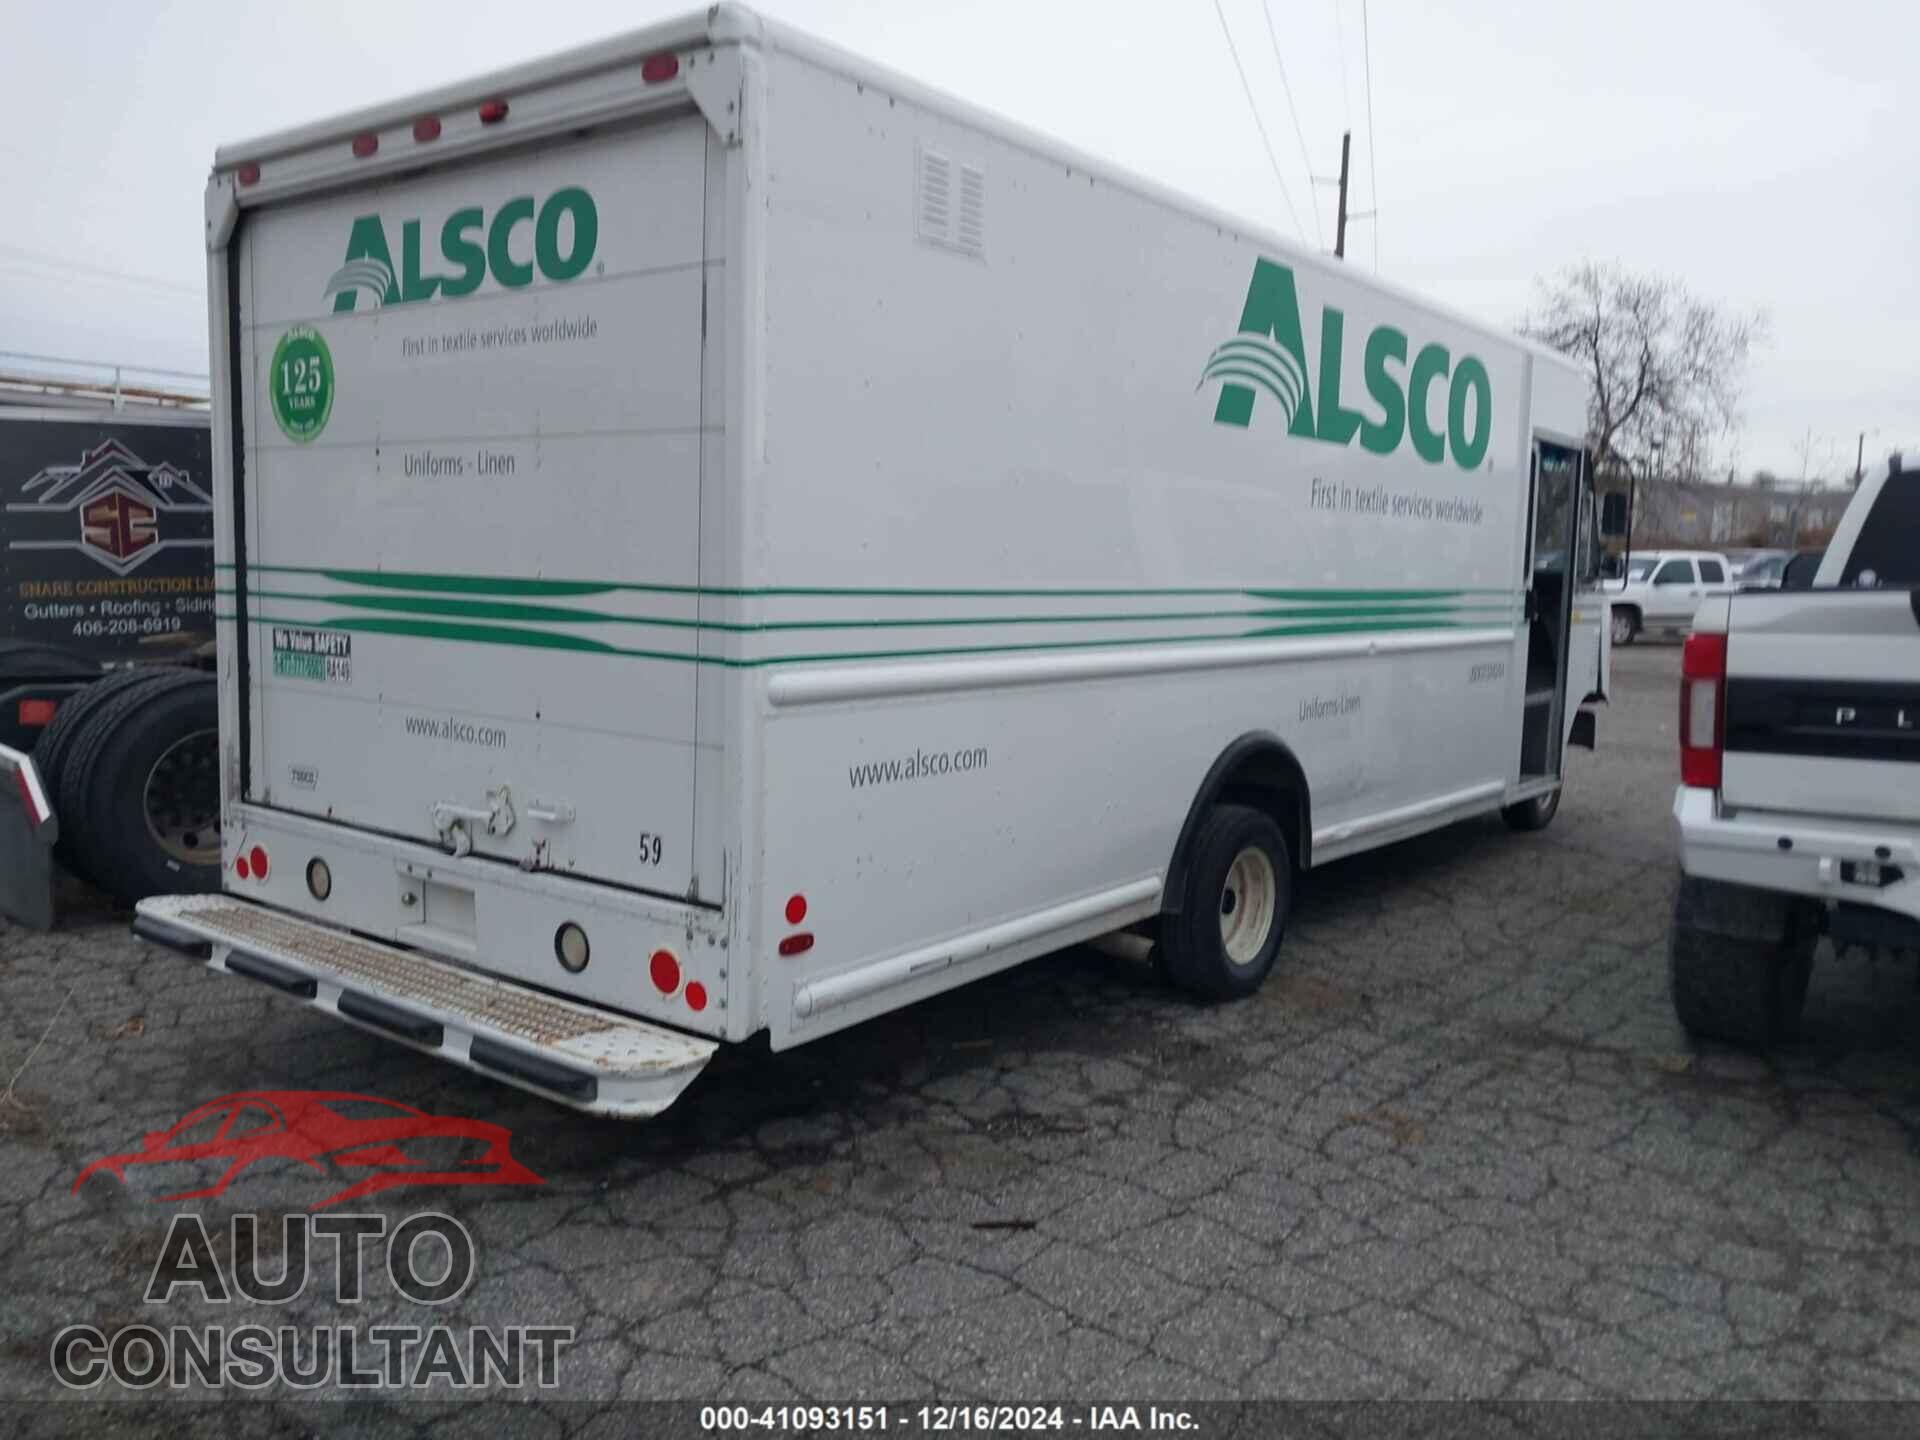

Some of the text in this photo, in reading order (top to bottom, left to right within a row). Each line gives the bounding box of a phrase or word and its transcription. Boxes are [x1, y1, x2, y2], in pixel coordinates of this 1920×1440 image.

[325, 186, 598, 313] ALSCO
[402, 316, 598, 357] First in textile services worldwide
[281, 356, 321, 395] 125
[1196, 255, 1491, 471] ALSCO
[404, 451, 464, 478] Uniforms
[478, 450, 515, 475] Linen
[1311, 478, 1483, 525] First in textile services worldwide
[76, 575, 192, 595] CONSTRUCTION
[24, 603, 84, 620] Gutters
[101, 599, 161, 617] Roofing
[72, 615, 181, 637] 406-208-6919
[314, 633, 348, 655] SAFETY
[405, 716, 507, 748] www.alsco.com
[849, 748, 988, 789] www.alsco.com
[639, 833, 662, 865] 59
